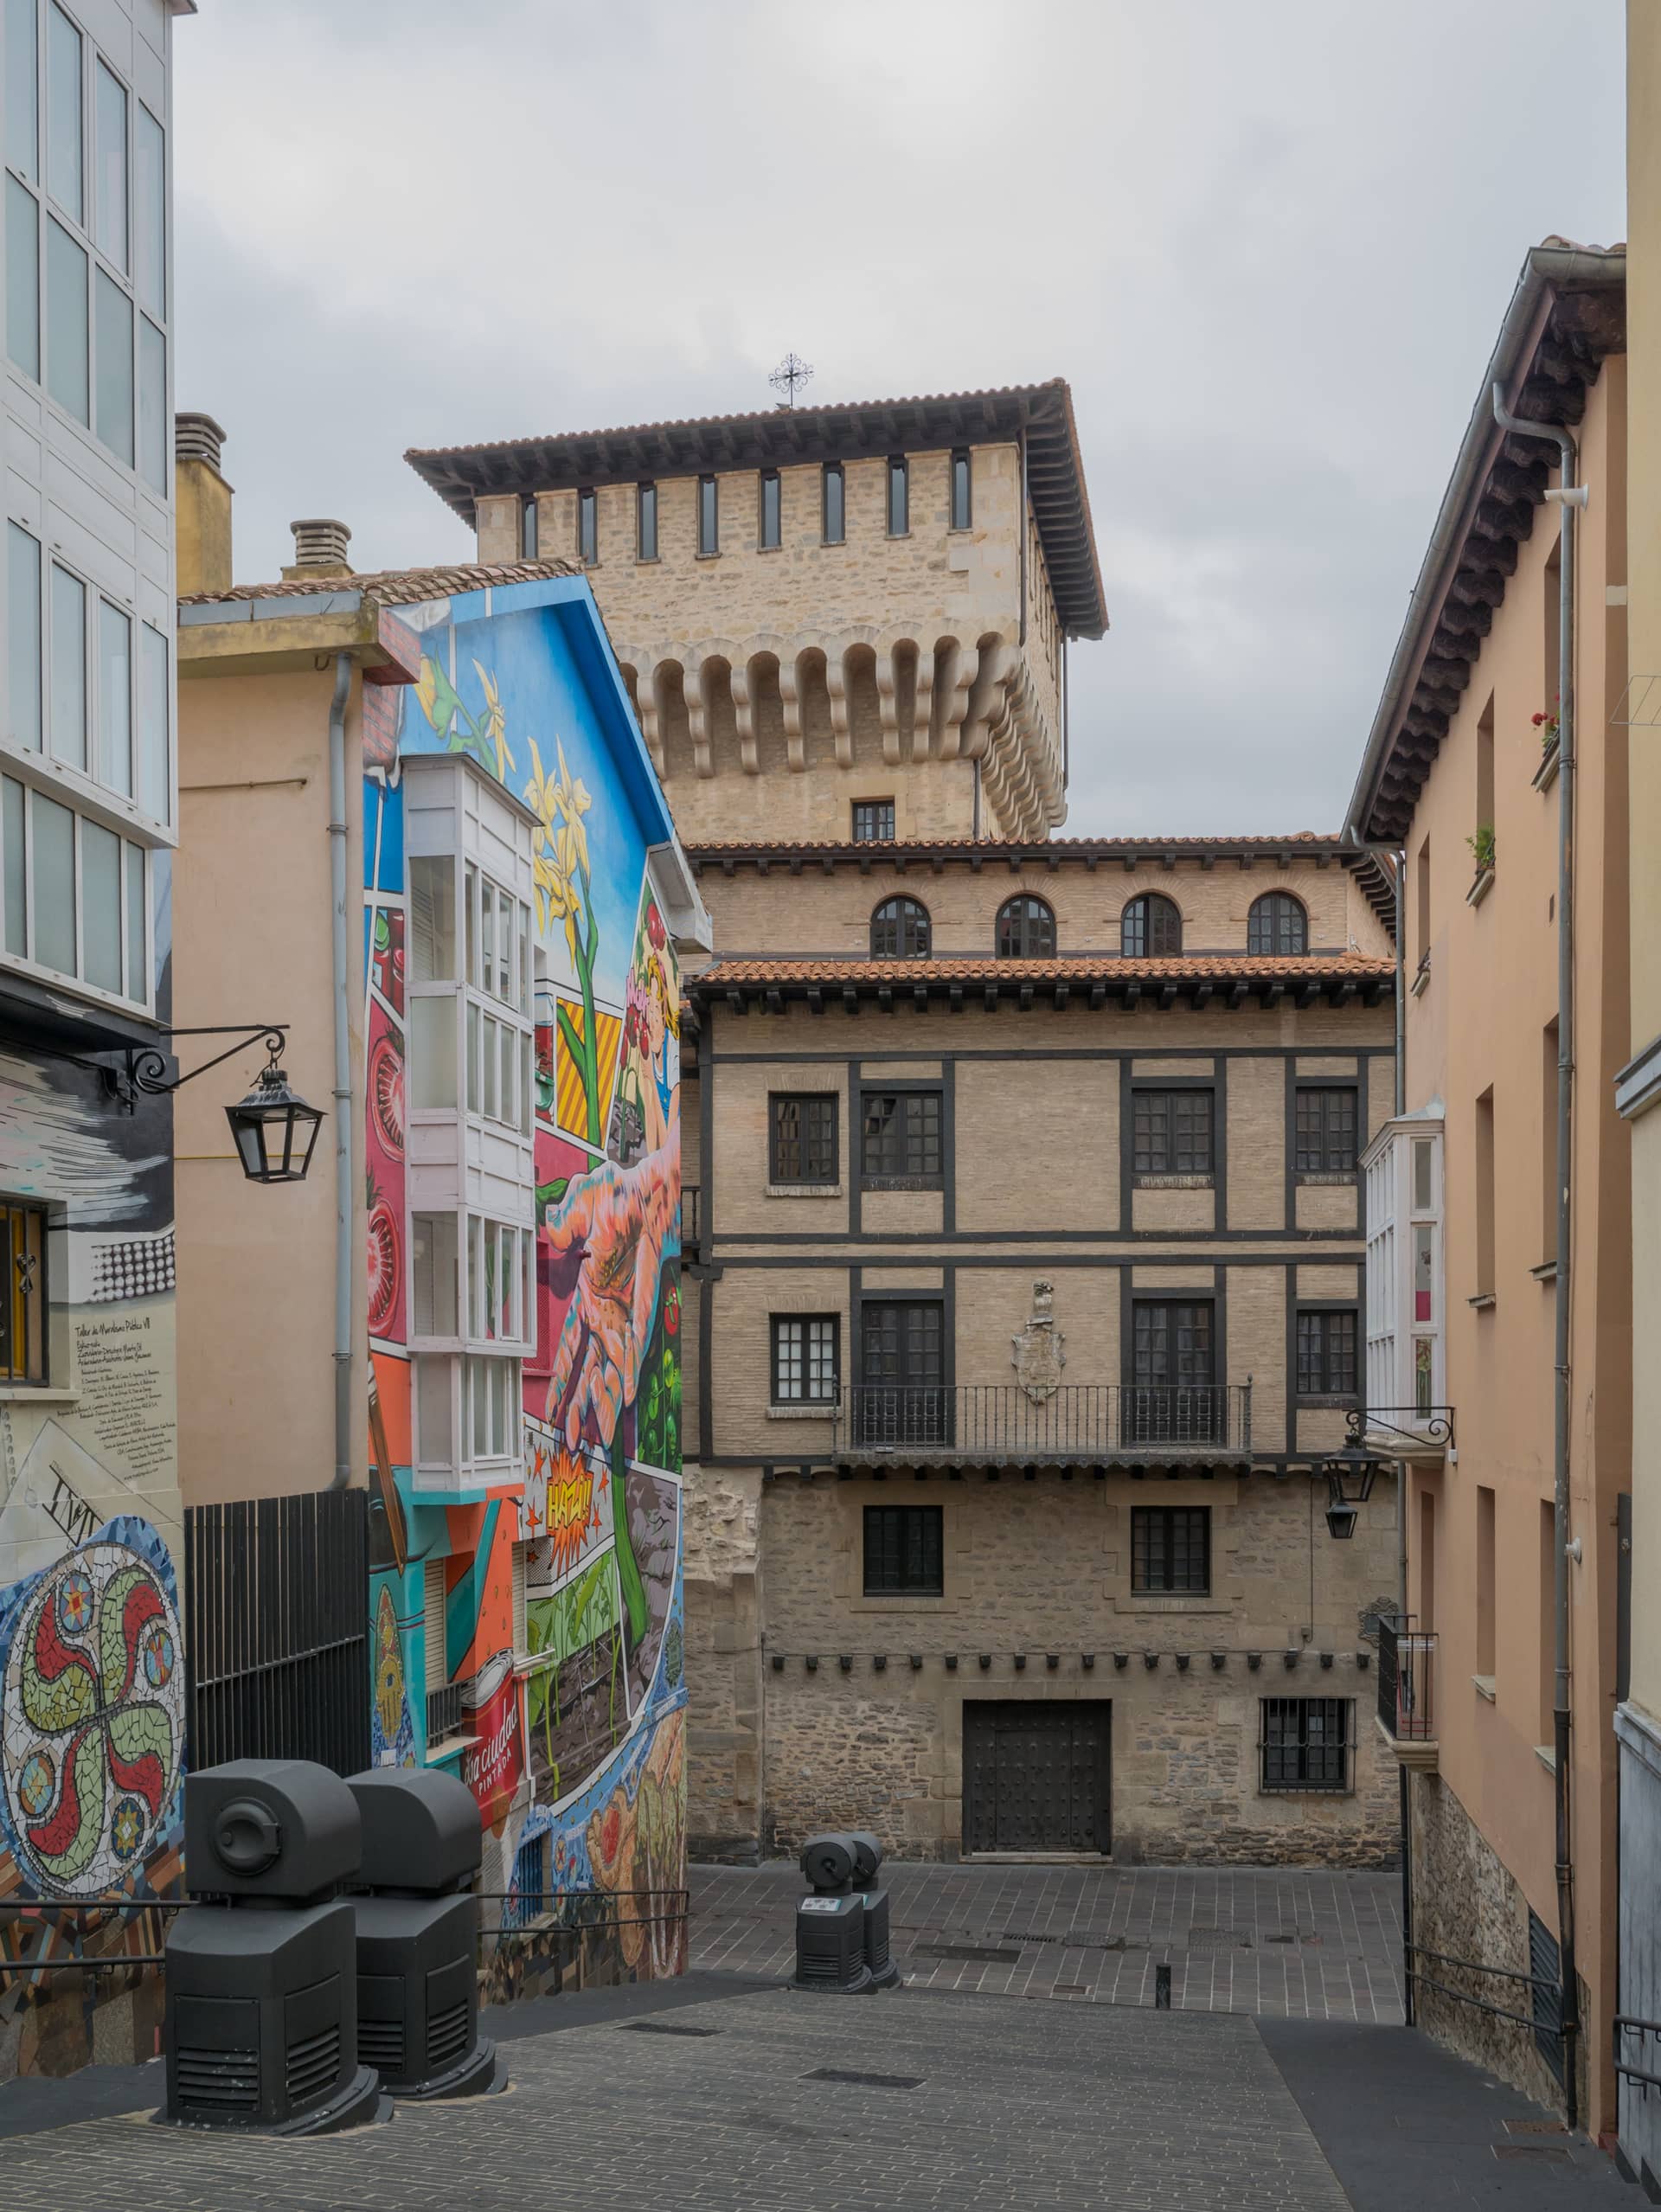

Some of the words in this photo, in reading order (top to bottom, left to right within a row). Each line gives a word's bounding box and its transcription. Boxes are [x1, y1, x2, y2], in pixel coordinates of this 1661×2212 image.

[464, 1749, 480, 1786] La
[481, 1683, 518, 1773] ciudad
[478, 1747, 512, 1797] PINTADA
